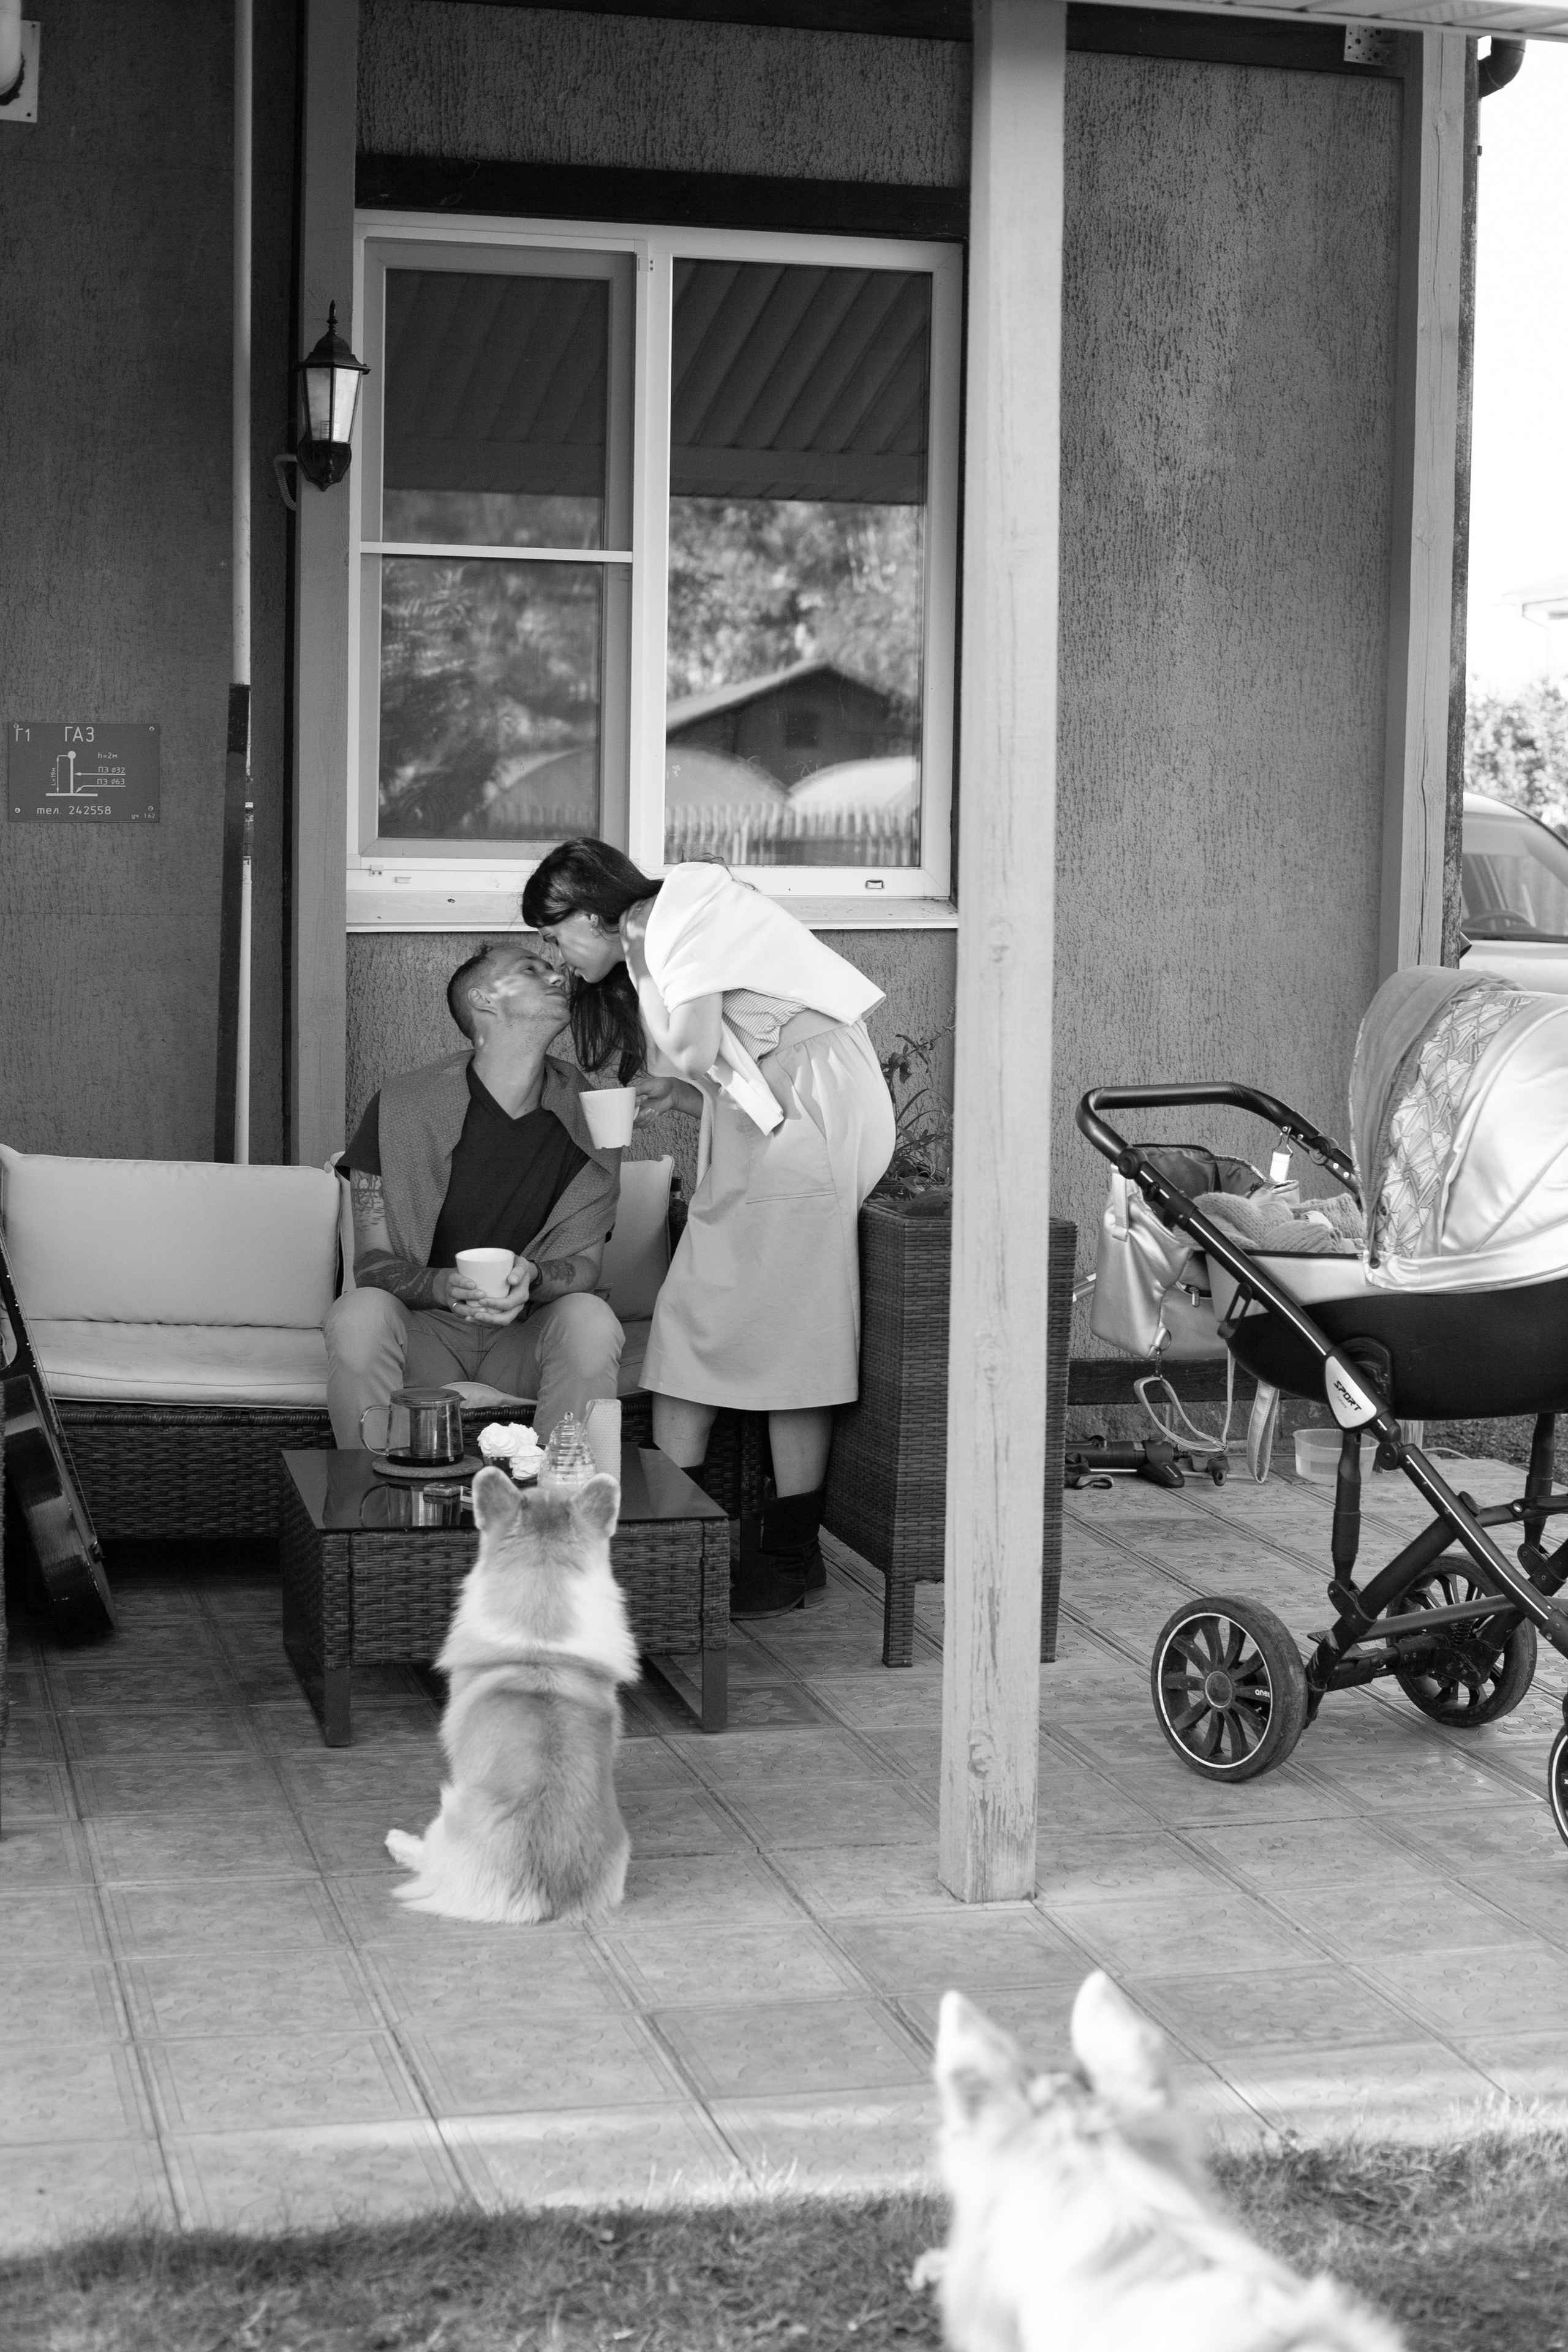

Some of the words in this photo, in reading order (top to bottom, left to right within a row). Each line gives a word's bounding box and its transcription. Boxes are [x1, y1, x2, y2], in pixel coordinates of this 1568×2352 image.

[64, 726, 94, 742] ГАЗ
[69, 805, 111, 815] 242558
[1333, 1380, 1362, 1411] SPORT
